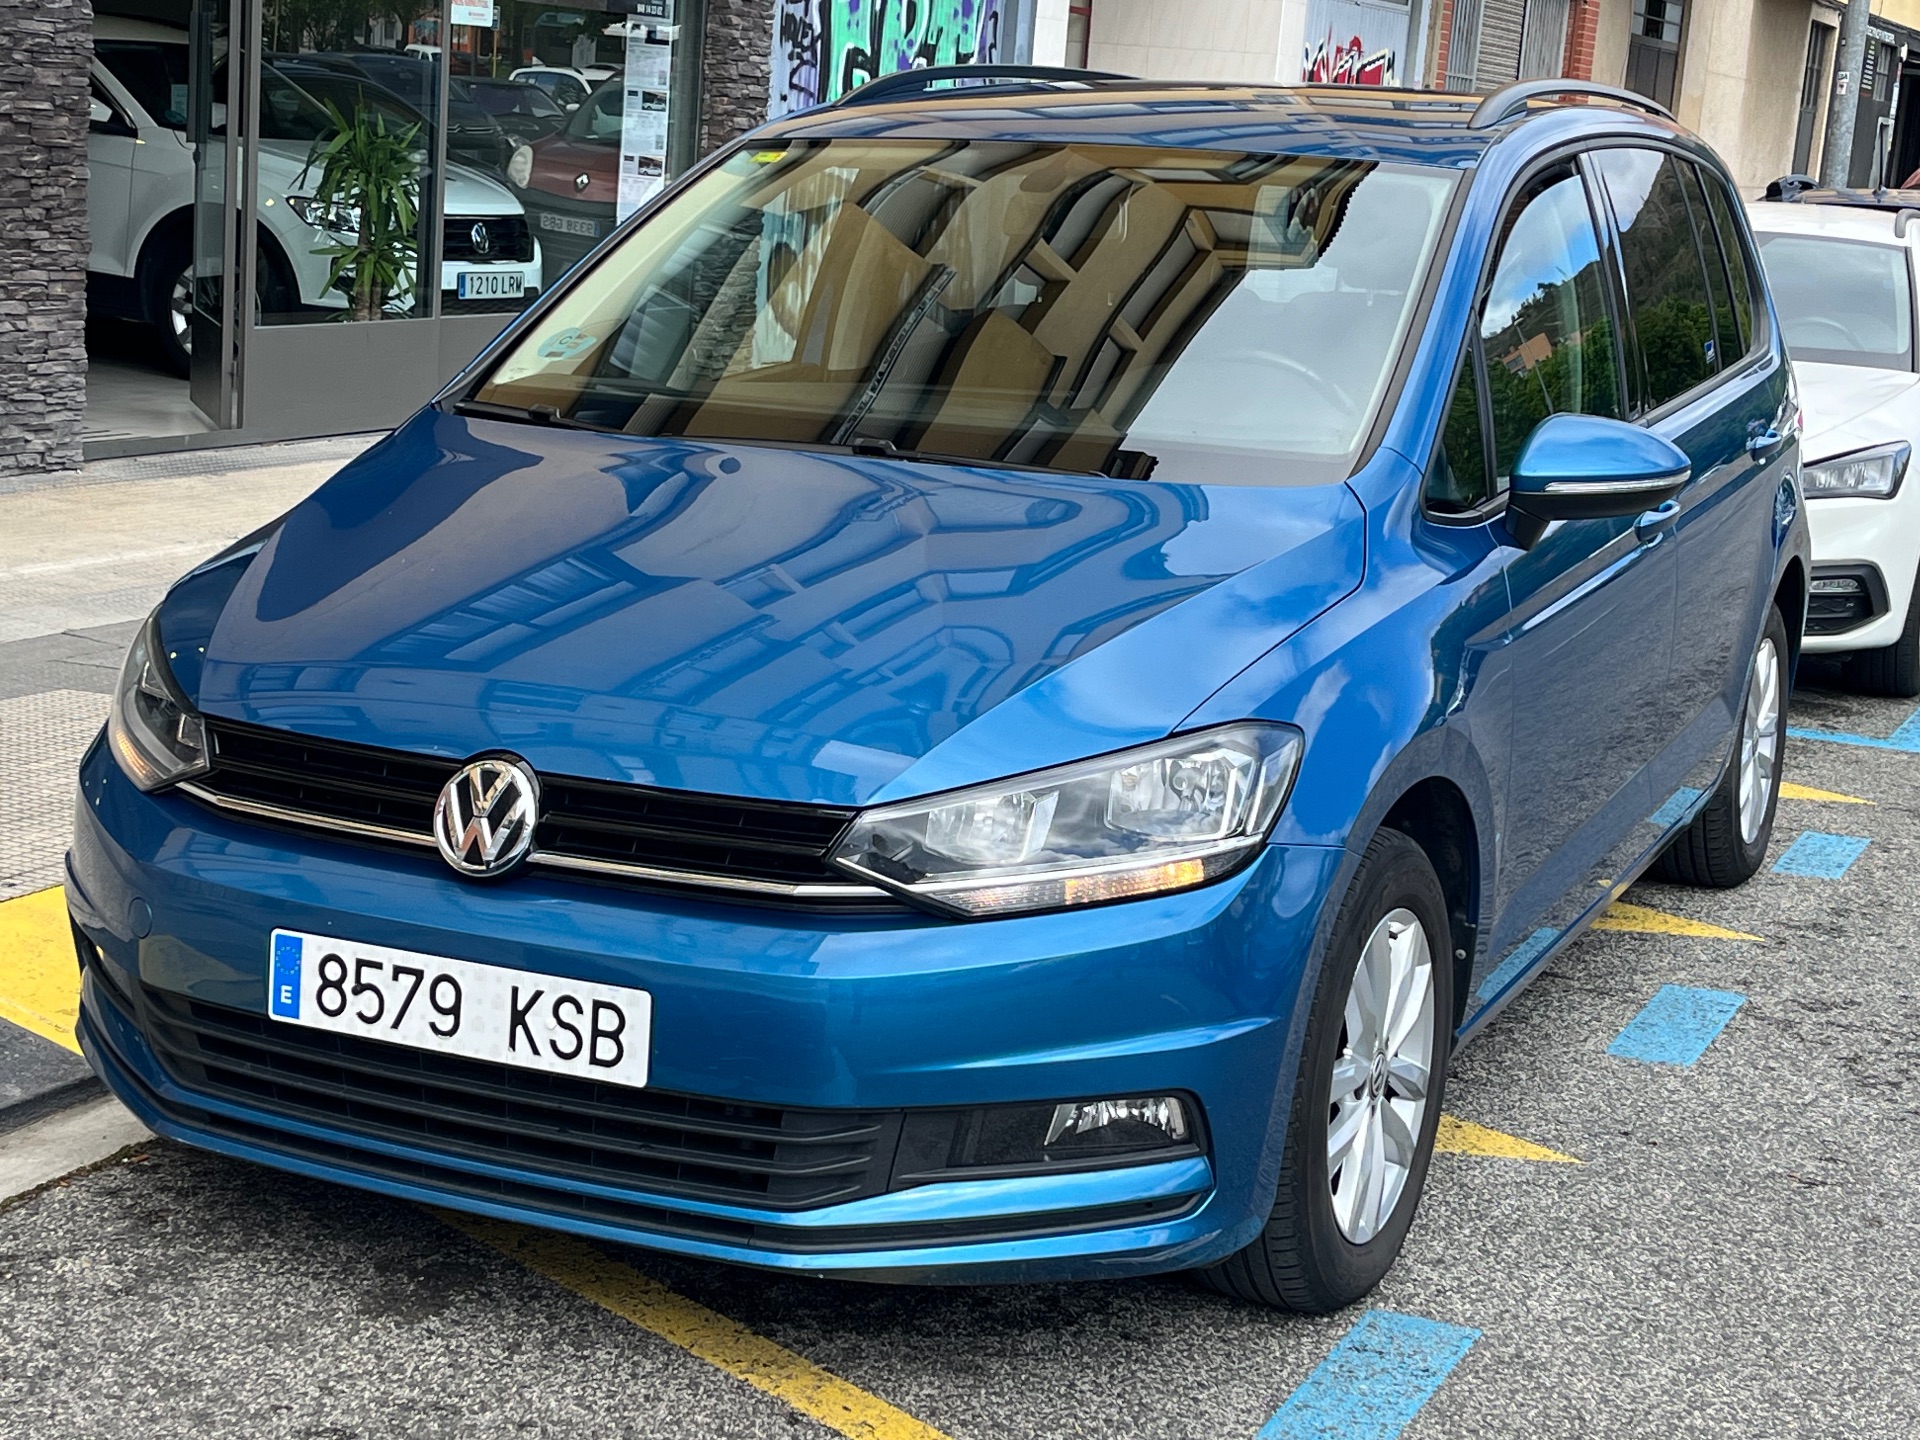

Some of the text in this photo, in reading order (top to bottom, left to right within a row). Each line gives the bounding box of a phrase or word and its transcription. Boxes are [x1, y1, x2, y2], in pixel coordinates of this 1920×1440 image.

[470, 275, 523, 295] 1210 LRM
[280, 985, 293, 1004] E
[315, 952, 626, 1069] 8579 KSB
